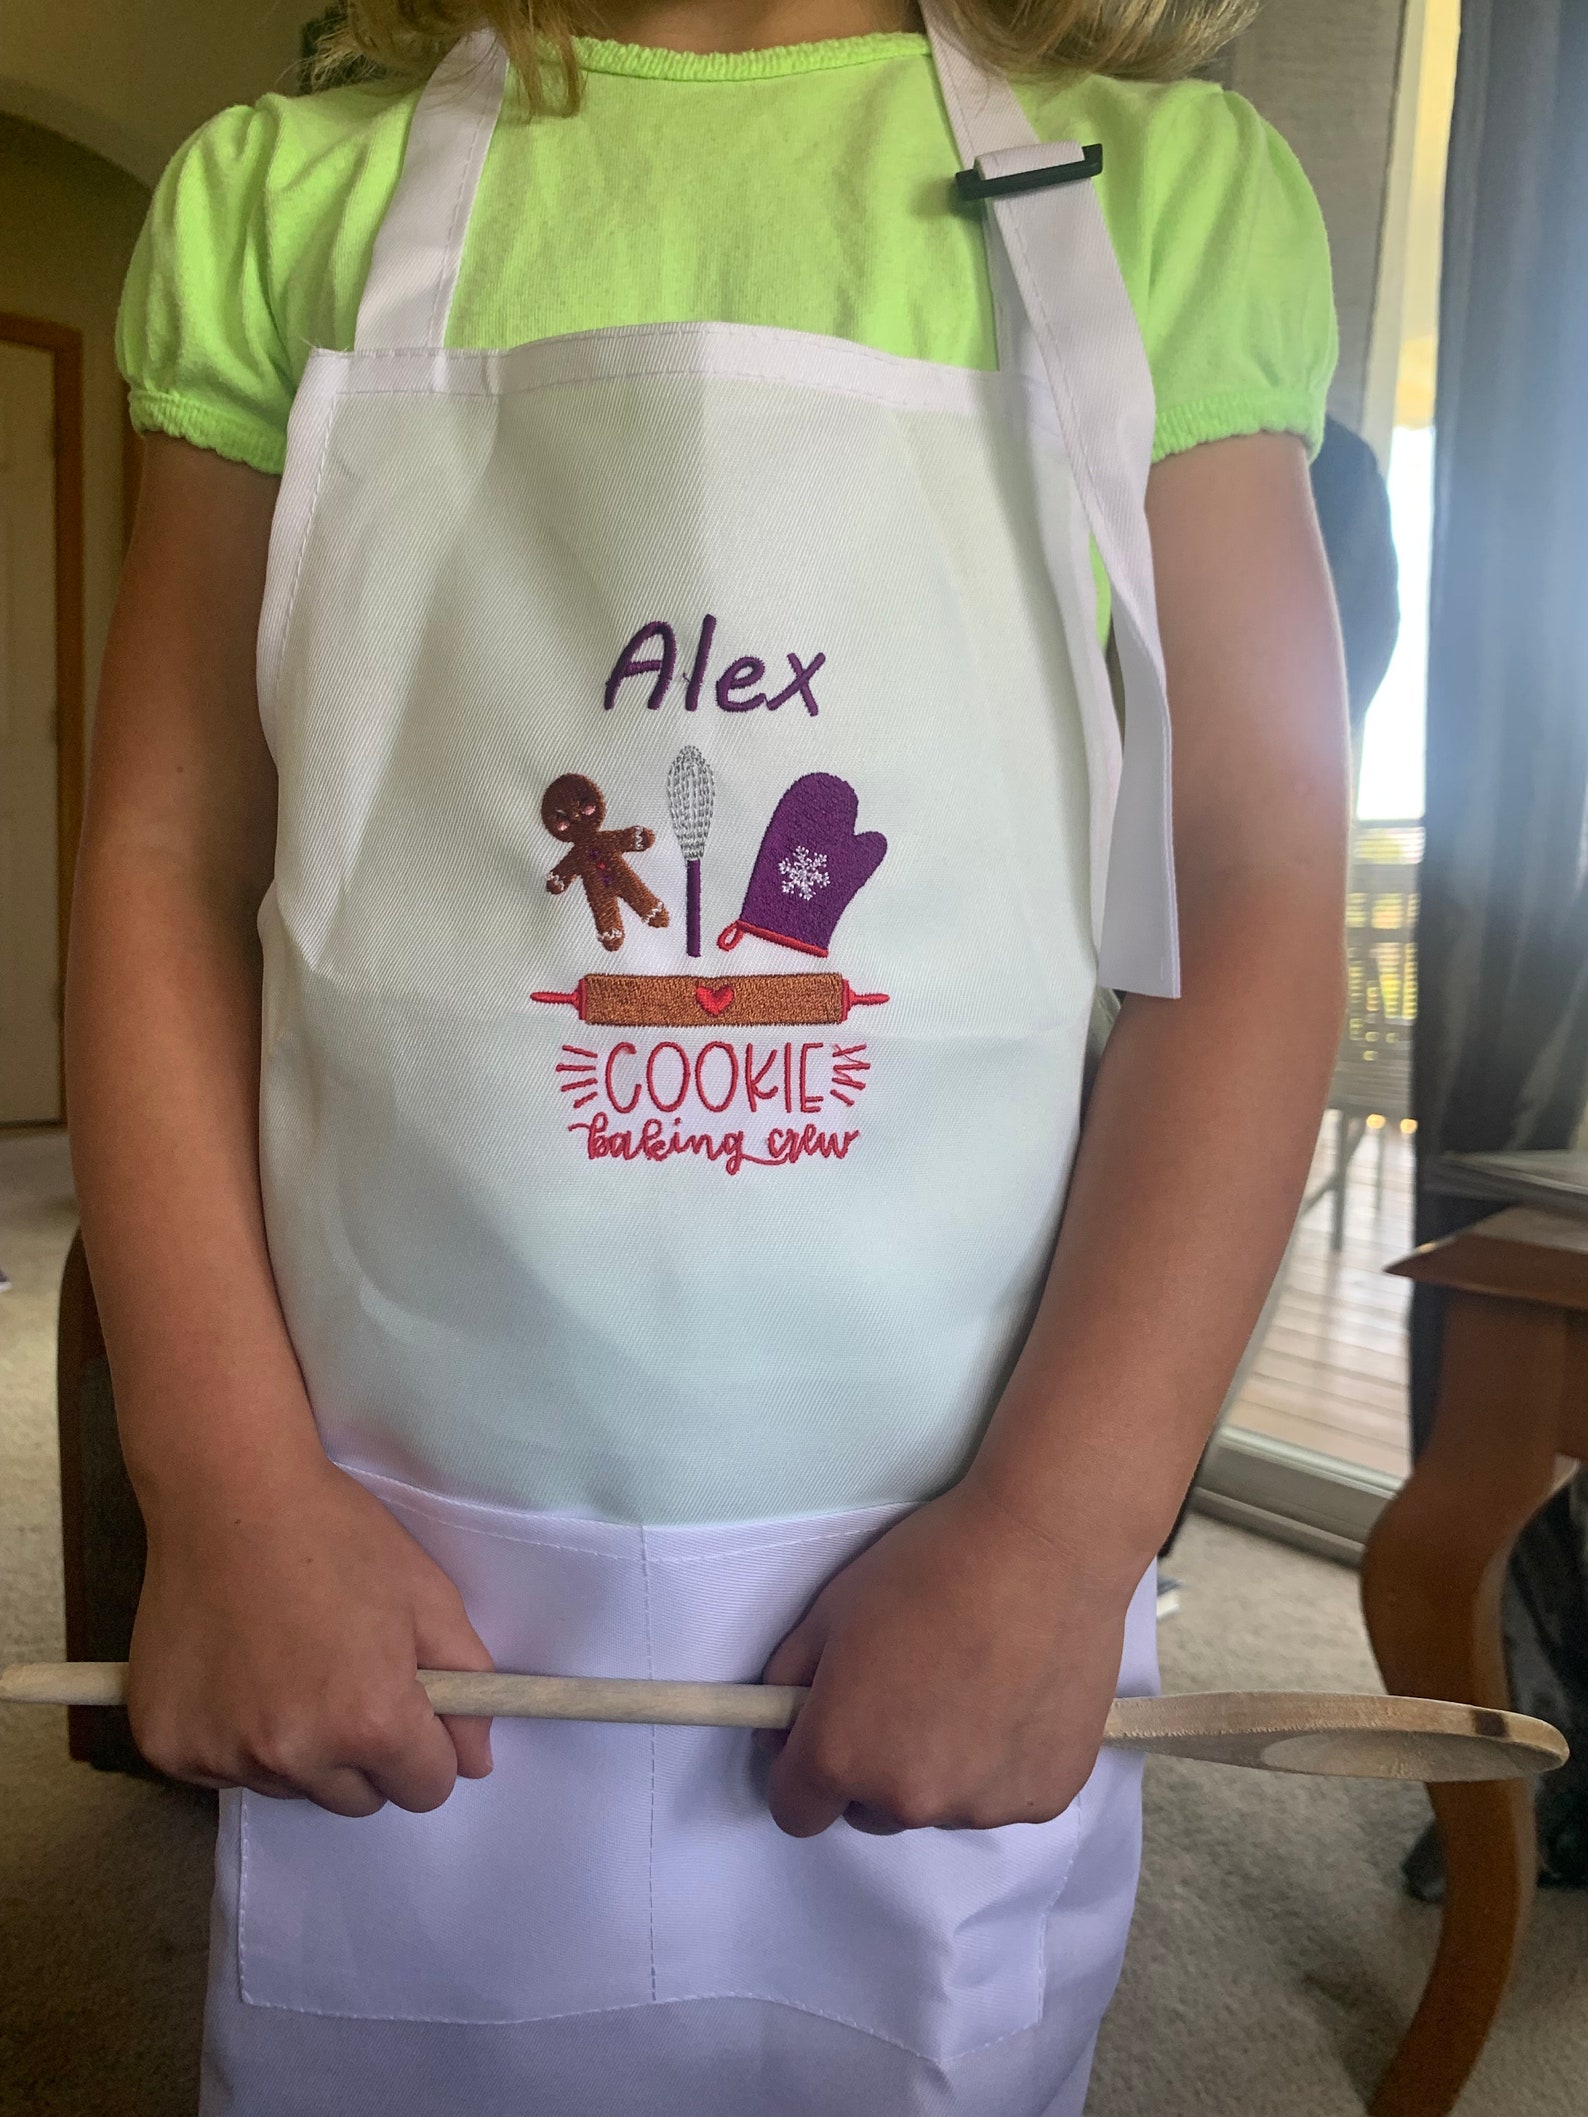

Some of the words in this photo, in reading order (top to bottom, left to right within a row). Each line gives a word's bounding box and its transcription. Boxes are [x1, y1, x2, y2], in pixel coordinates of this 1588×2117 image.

[604, 613, 826, 717] Alex
[604, 1041, 825, 1114] COOKIE
[567, 1111, 746, 1176] baking
[766, 1123, 860, 1165] crew
